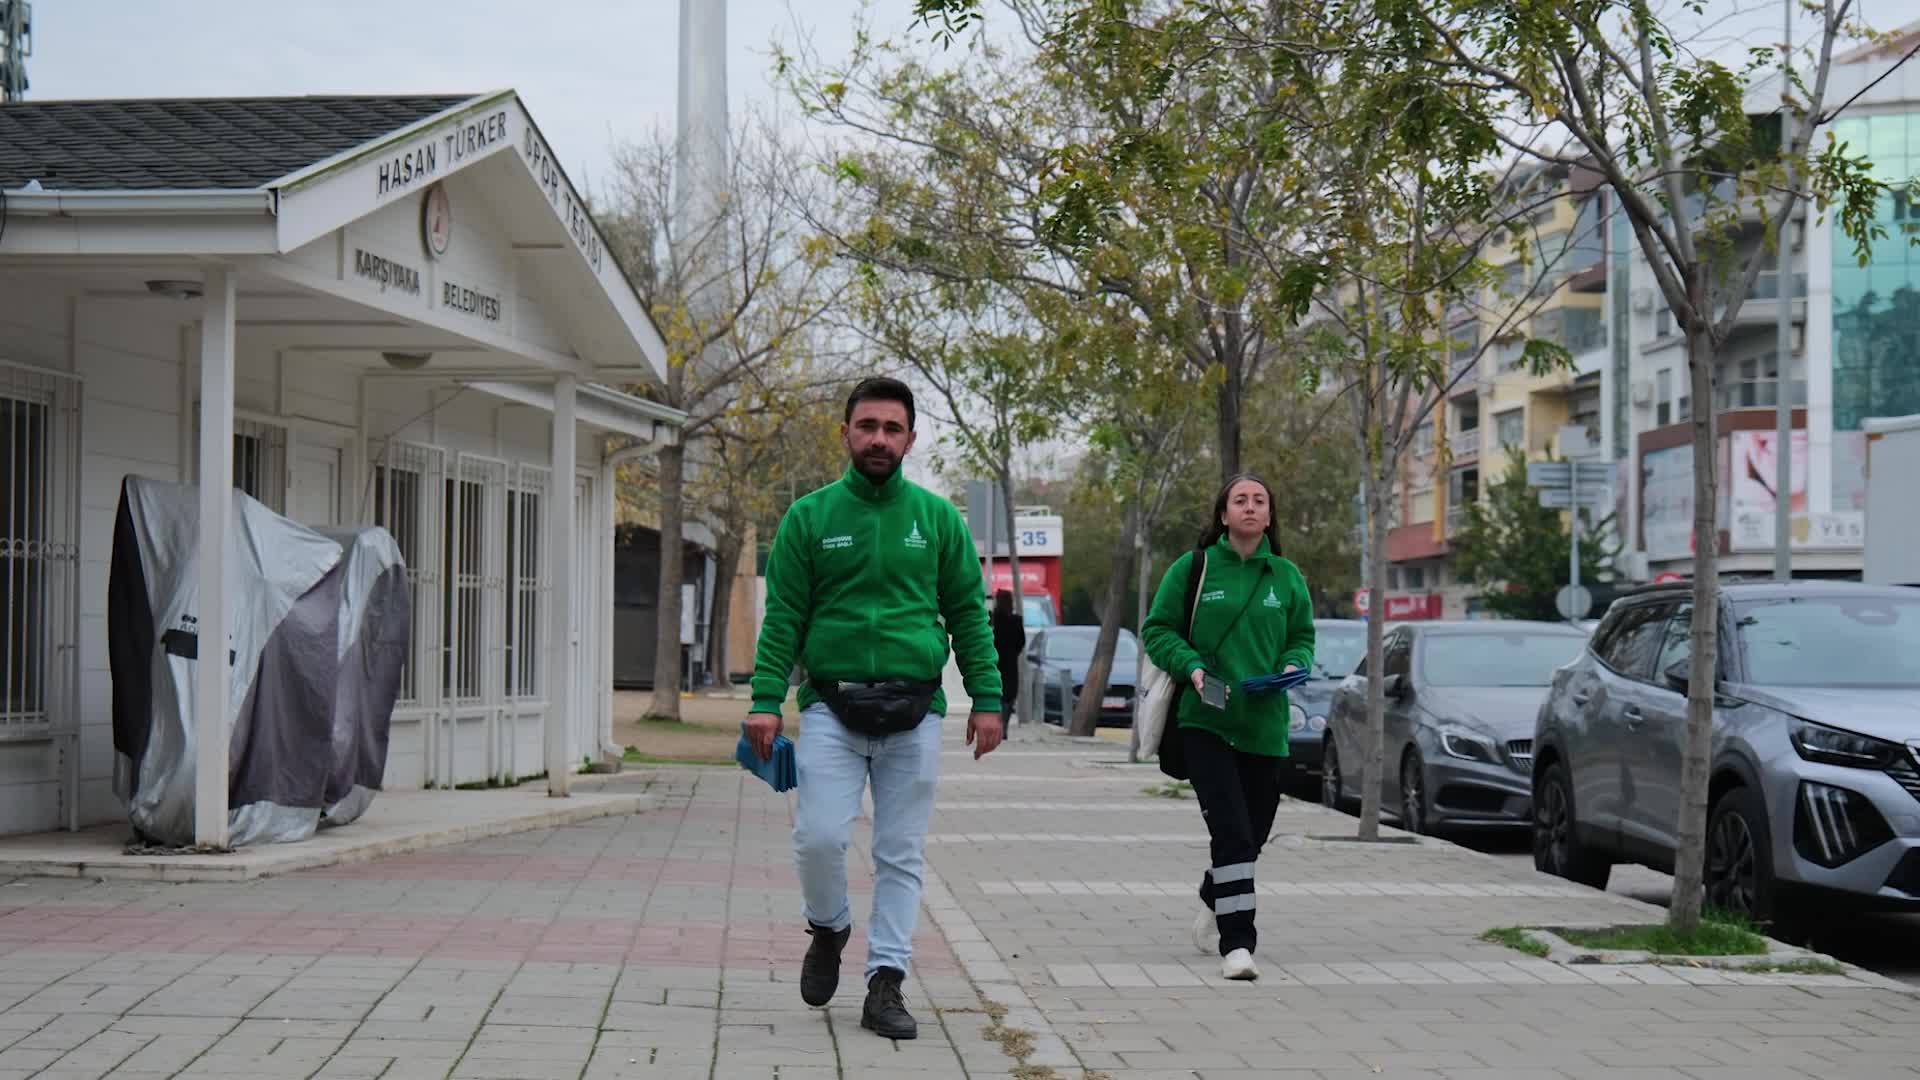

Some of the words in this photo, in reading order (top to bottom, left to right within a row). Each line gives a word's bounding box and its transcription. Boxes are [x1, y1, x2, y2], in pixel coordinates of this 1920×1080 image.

[378, 141, 437, 195] HASAN
[445, 111, 506, 163] TÜRKER
[525, 127, 558, 206] SPOR
[355, 248, 420, 294] KARŞIYAKA
[443, 280, 501, 320] BELEDİYESİ
[1023, 530, 1047, 546] 35
